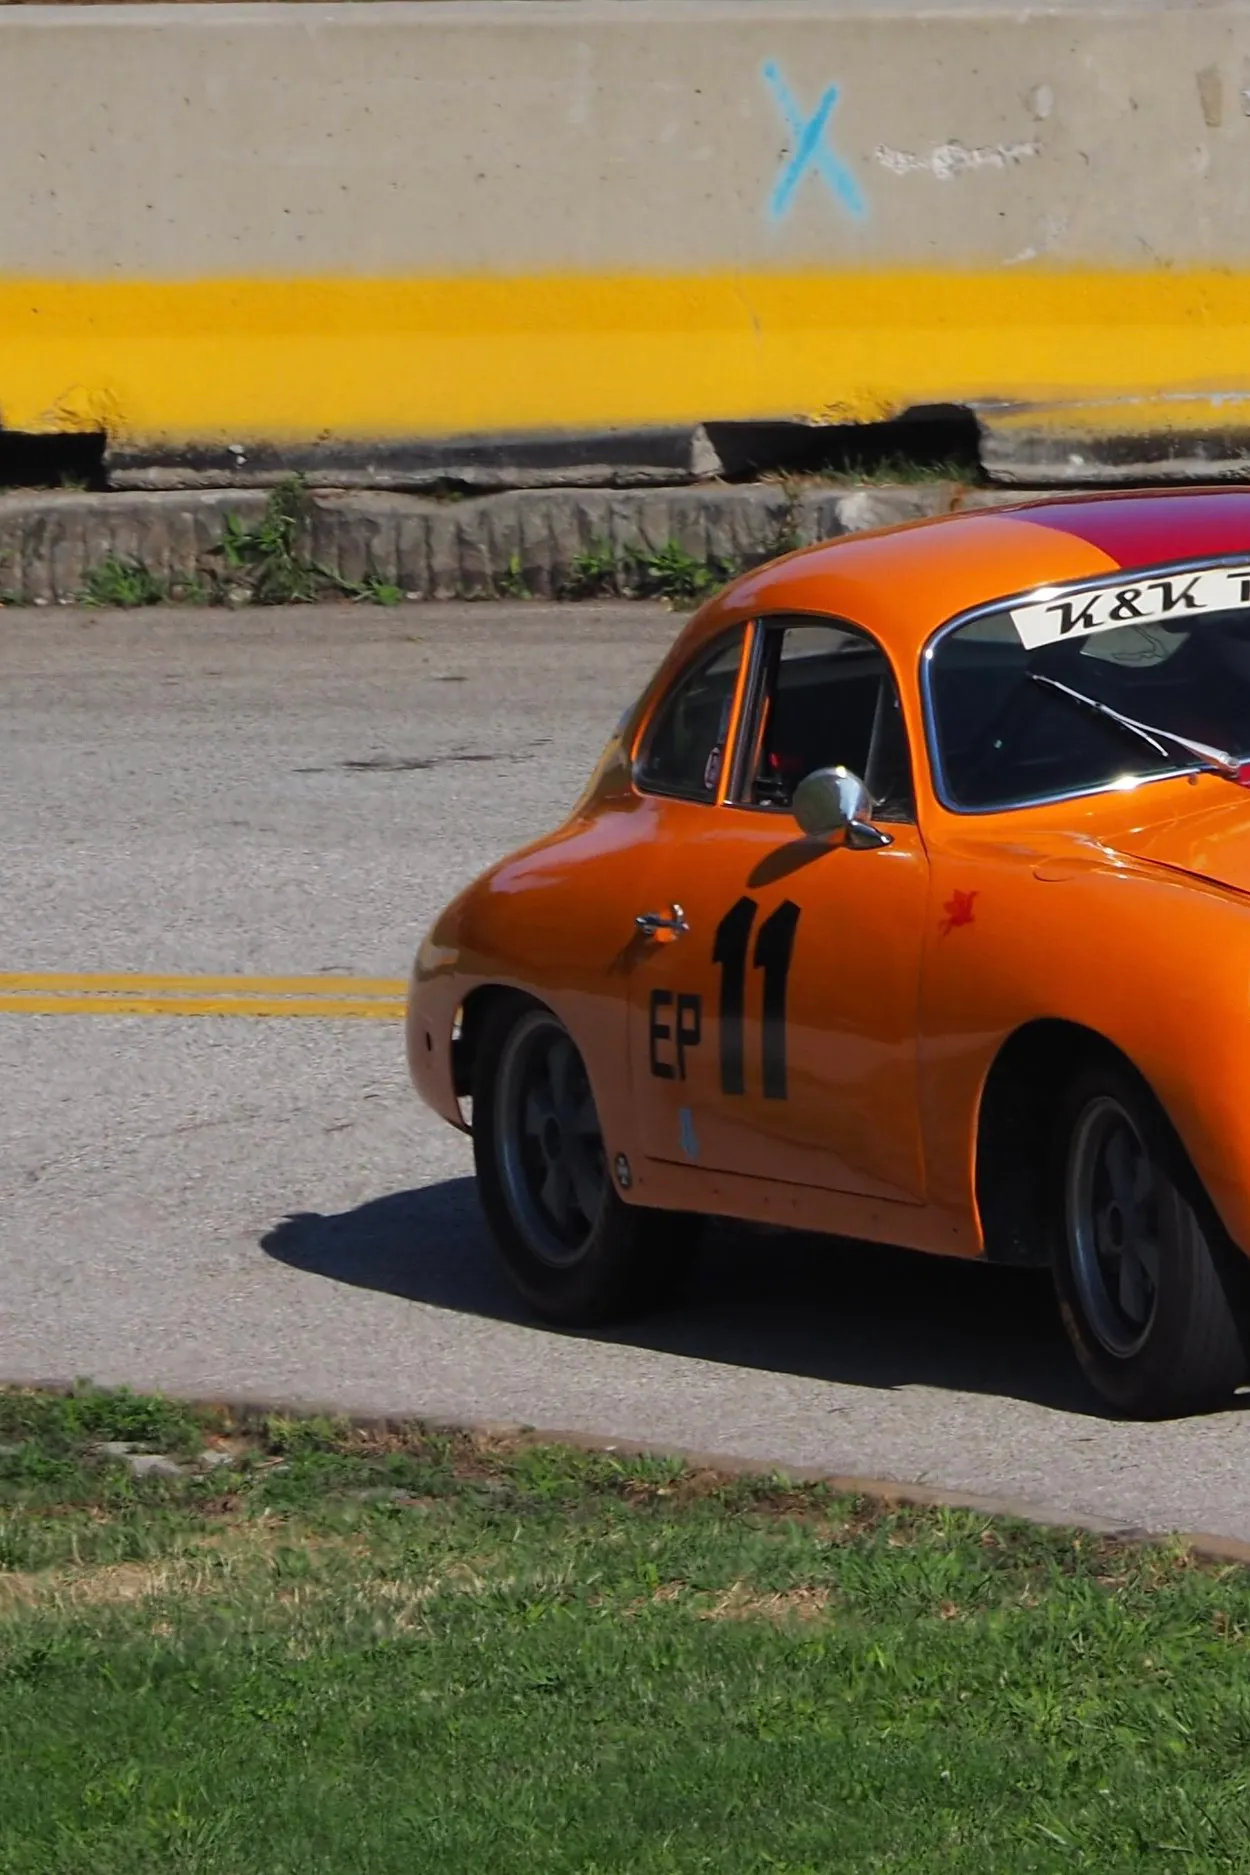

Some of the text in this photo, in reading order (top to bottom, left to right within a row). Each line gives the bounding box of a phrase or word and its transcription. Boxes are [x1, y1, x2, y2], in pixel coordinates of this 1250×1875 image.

[1046, 576, 1208, 634] K&K
[650, 989, 702, 1080] EP
[713, 896, 802, 1101] 11
